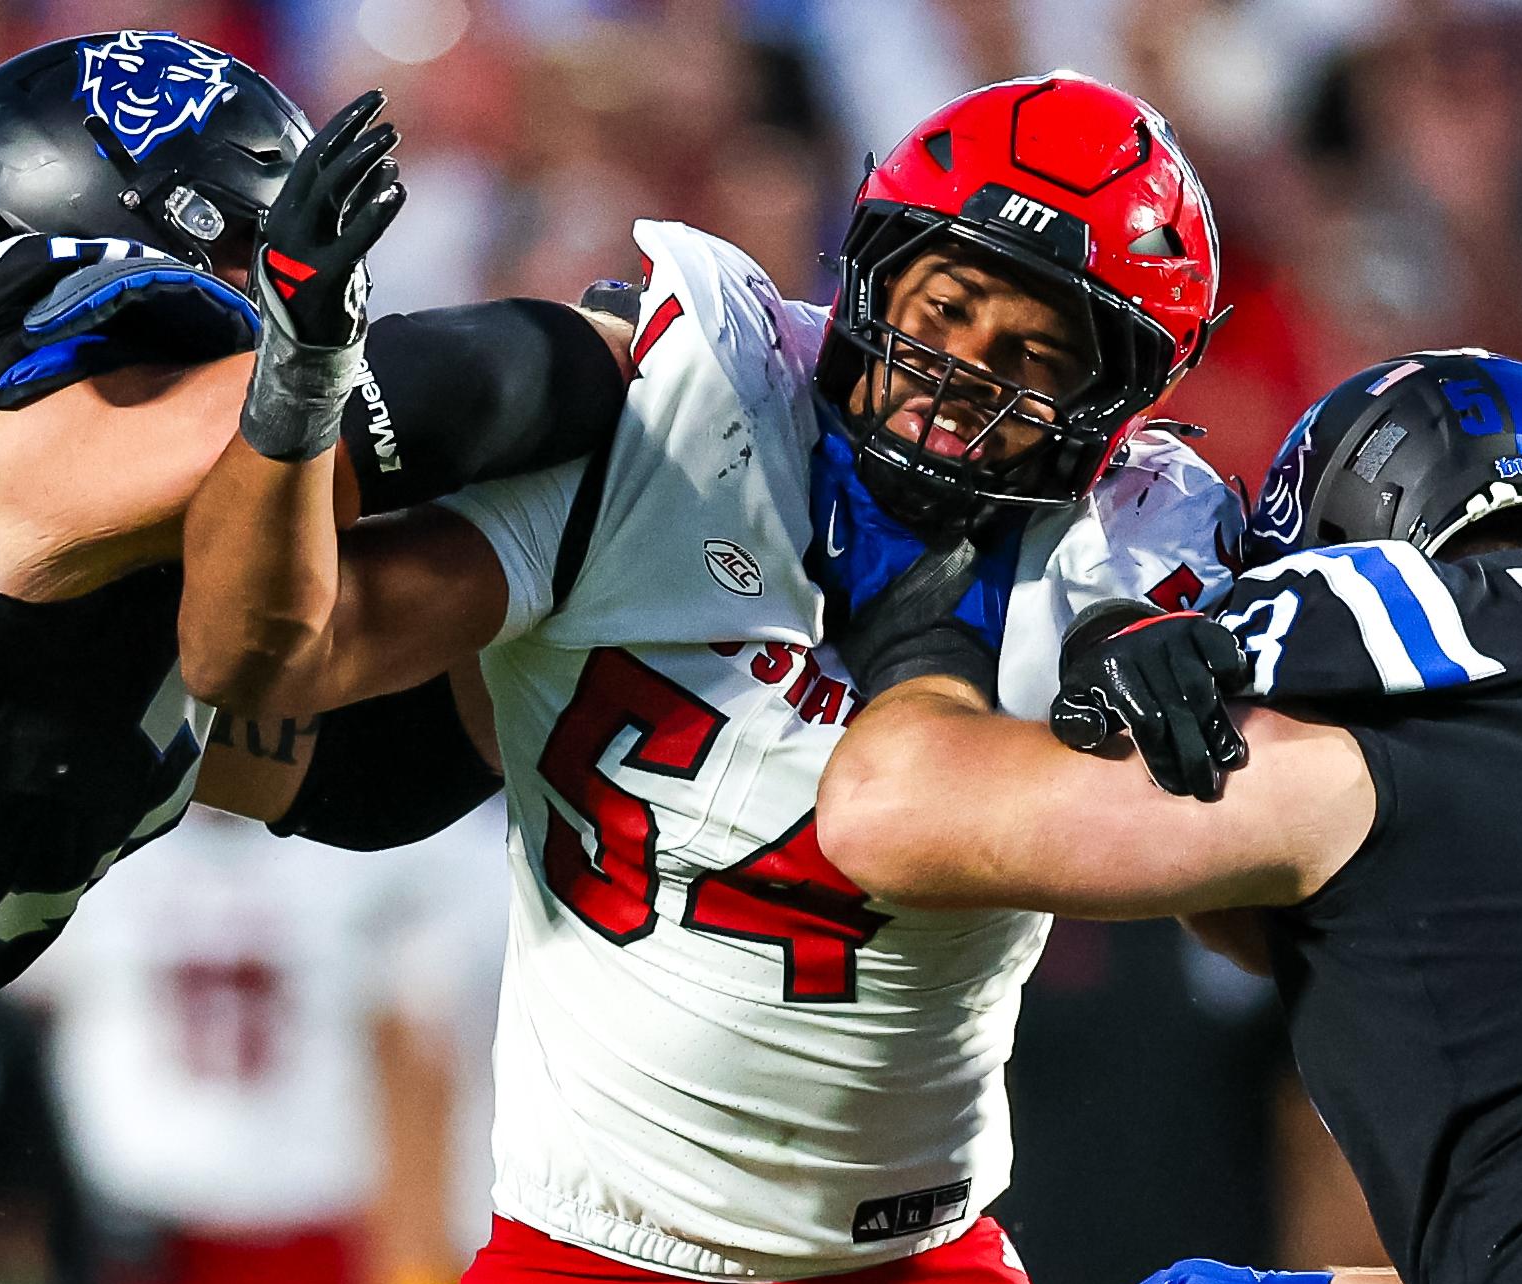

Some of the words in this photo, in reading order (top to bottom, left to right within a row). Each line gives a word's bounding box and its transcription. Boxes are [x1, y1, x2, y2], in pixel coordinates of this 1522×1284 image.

[998, 193, 1059, 233] HTT
[351, 358, 397, 458] Muelle
[711, 550, 761, 588] ACC
[536, 646, 896, 1003] 54
